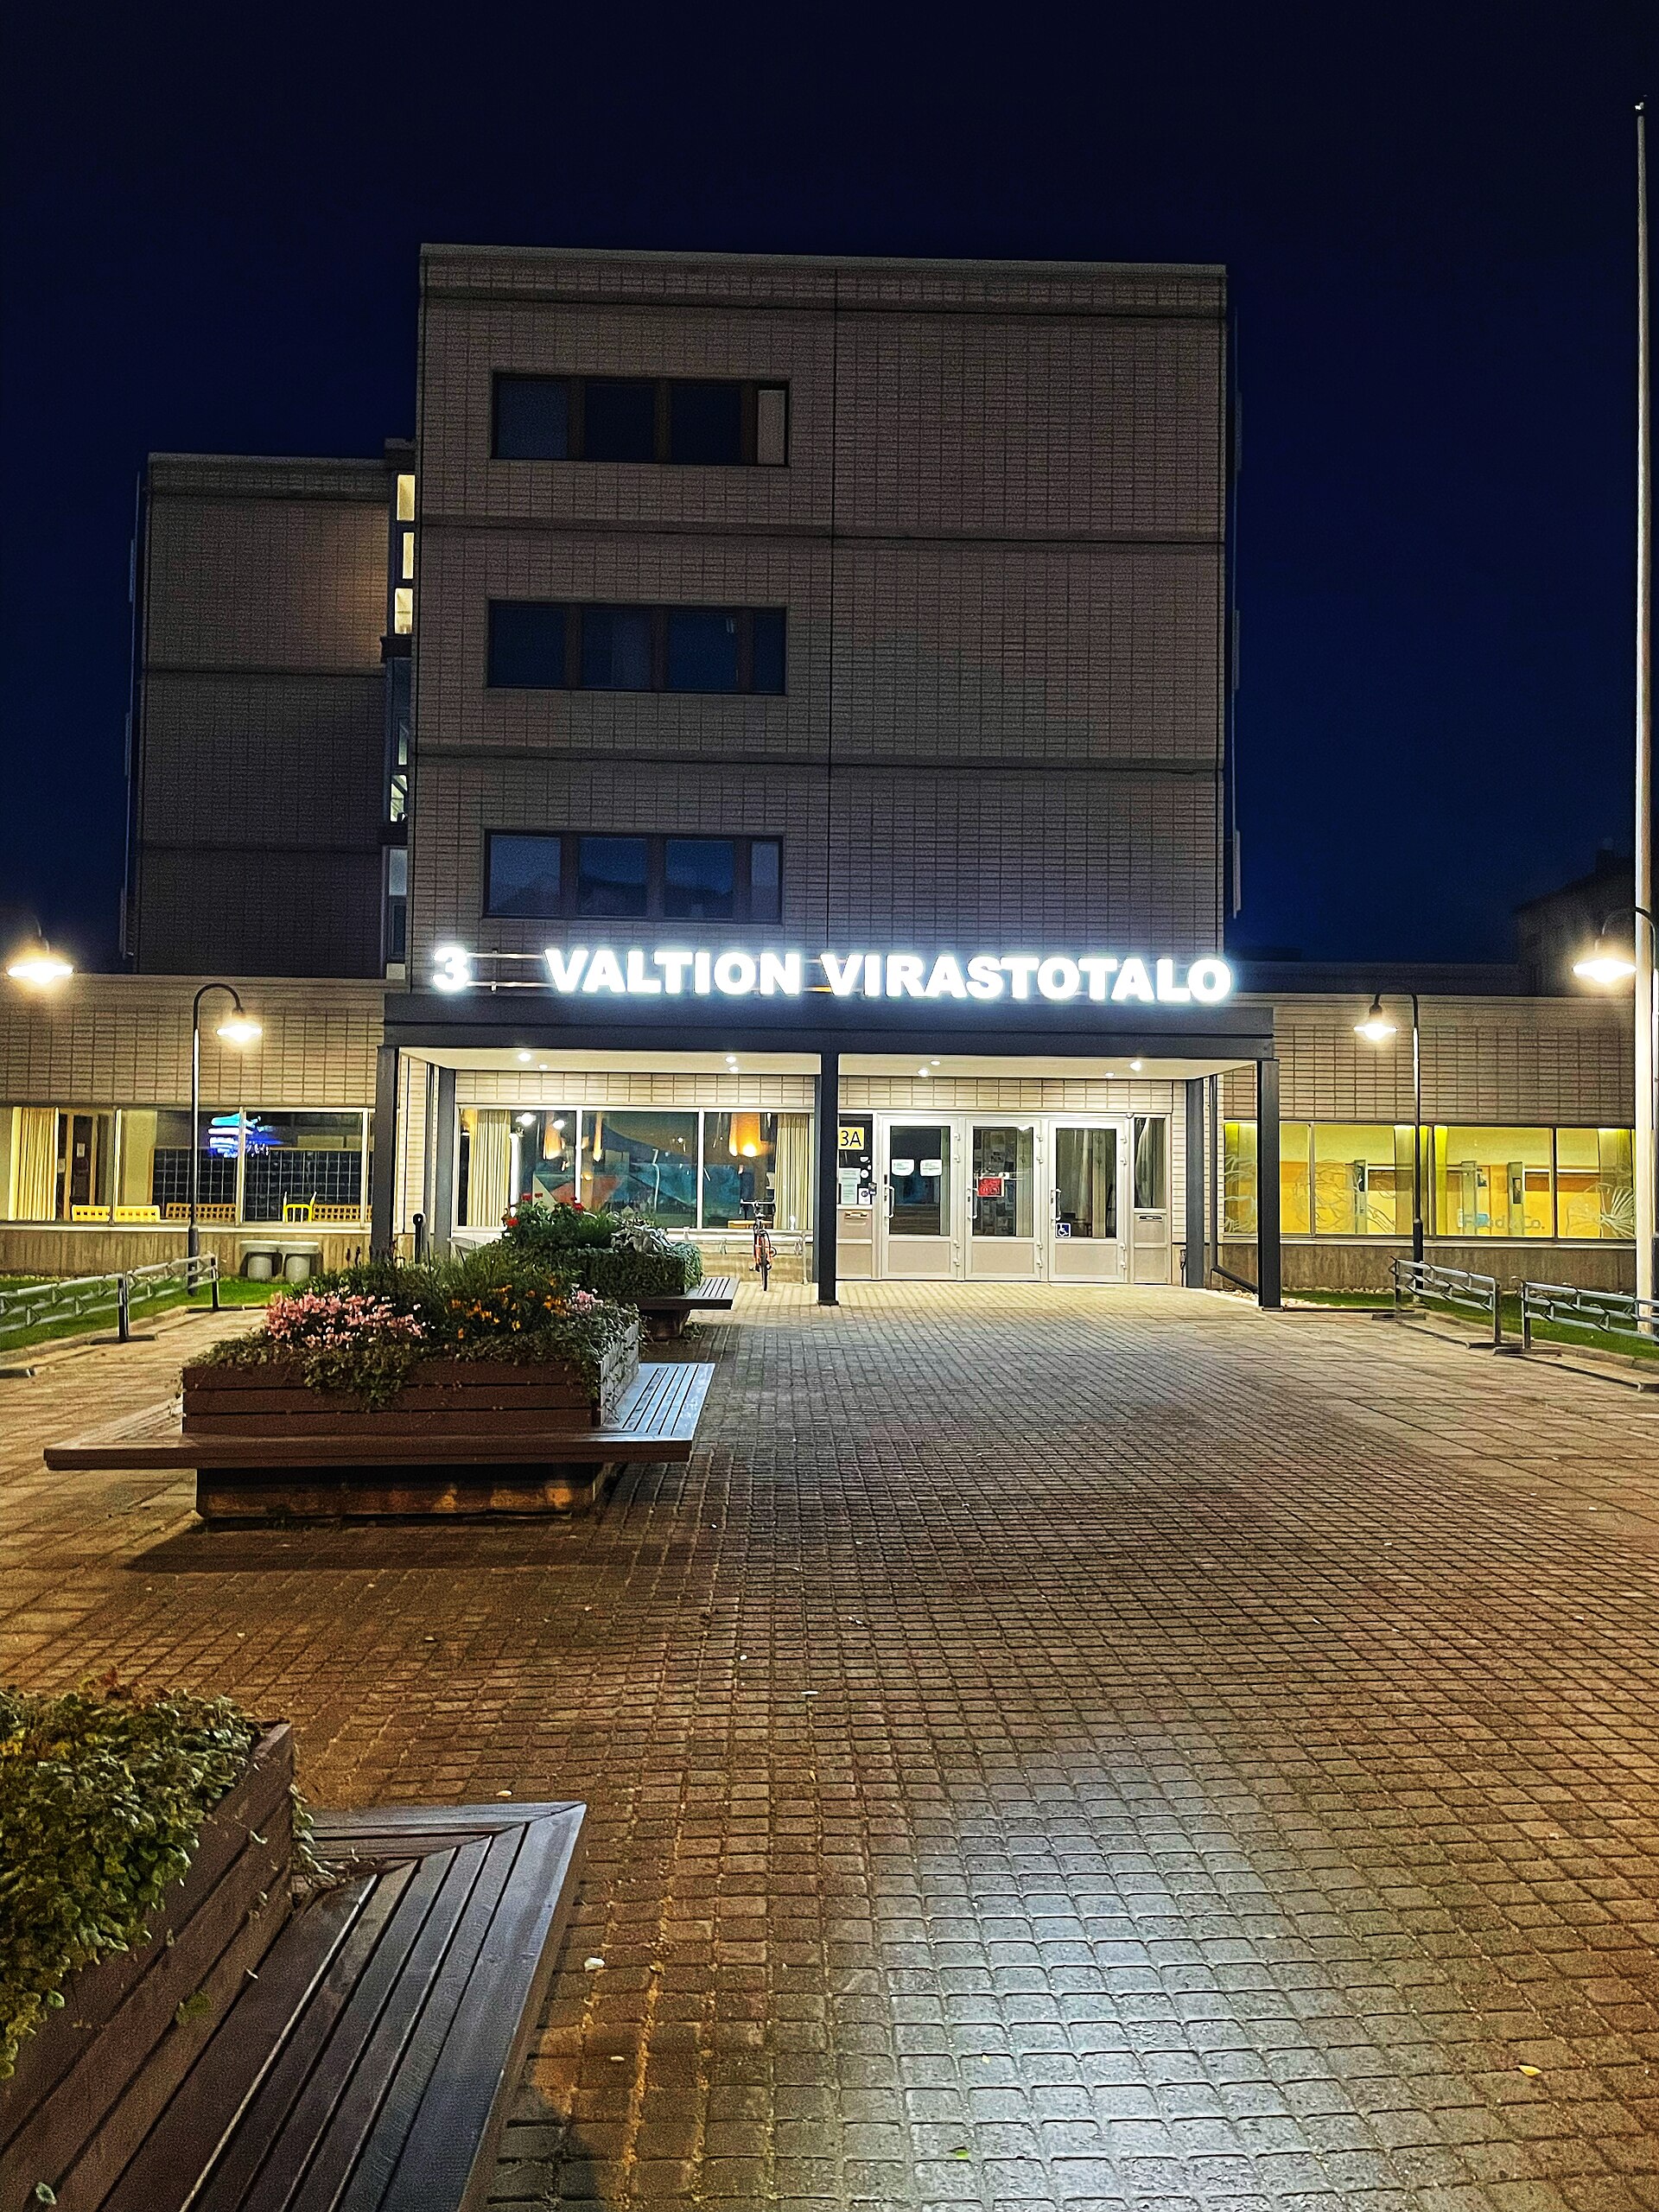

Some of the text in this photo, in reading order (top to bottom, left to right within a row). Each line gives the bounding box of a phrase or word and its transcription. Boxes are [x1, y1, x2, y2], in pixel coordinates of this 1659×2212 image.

[432, 946, 1232, 1002] 3 VALTION VIRASTOTALO
[841, 1130, 861, 1147] 3A
